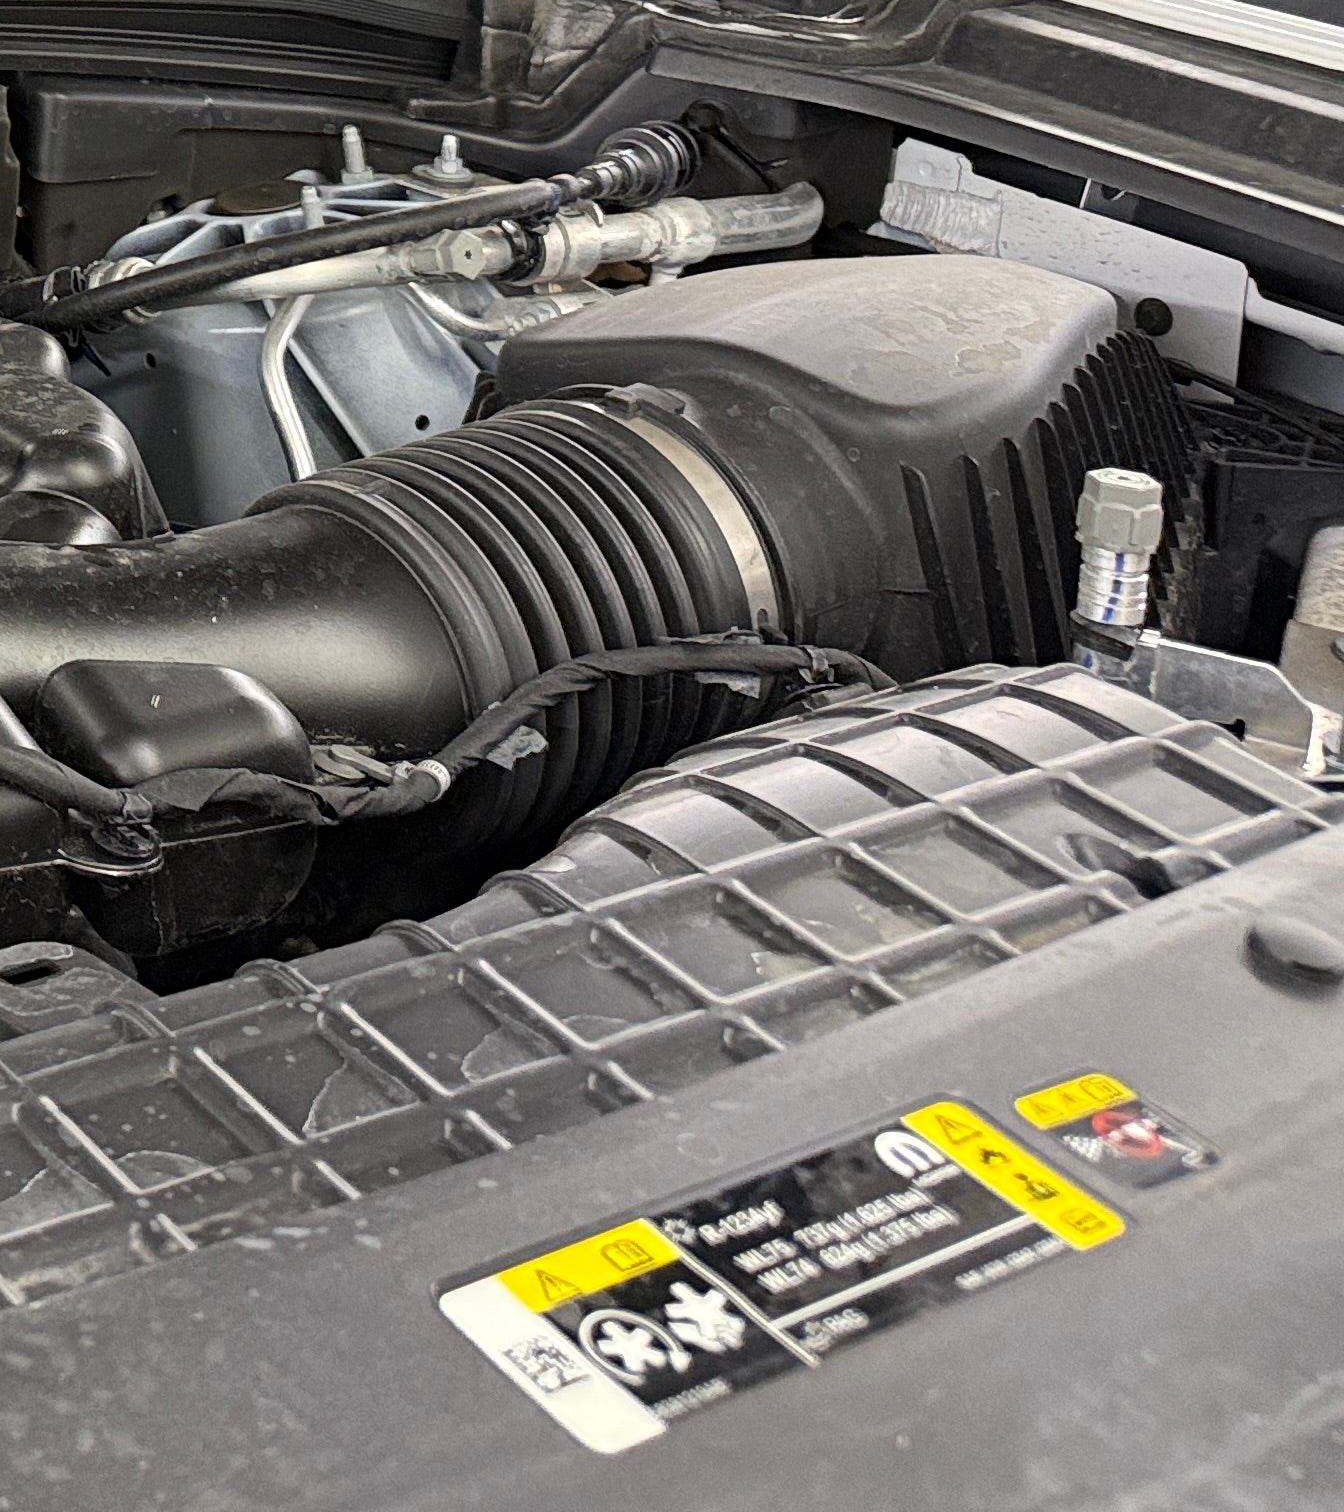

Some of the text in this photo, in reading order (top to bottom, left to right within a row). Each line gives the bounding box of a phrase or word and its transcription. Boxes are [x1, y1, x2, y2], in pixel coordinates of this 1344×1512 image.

[698, 1199, 786, 1246] R-1234yf
[733, 1238, 798, 1273] WL75
[756, 1257, 822, 1294] WL74
